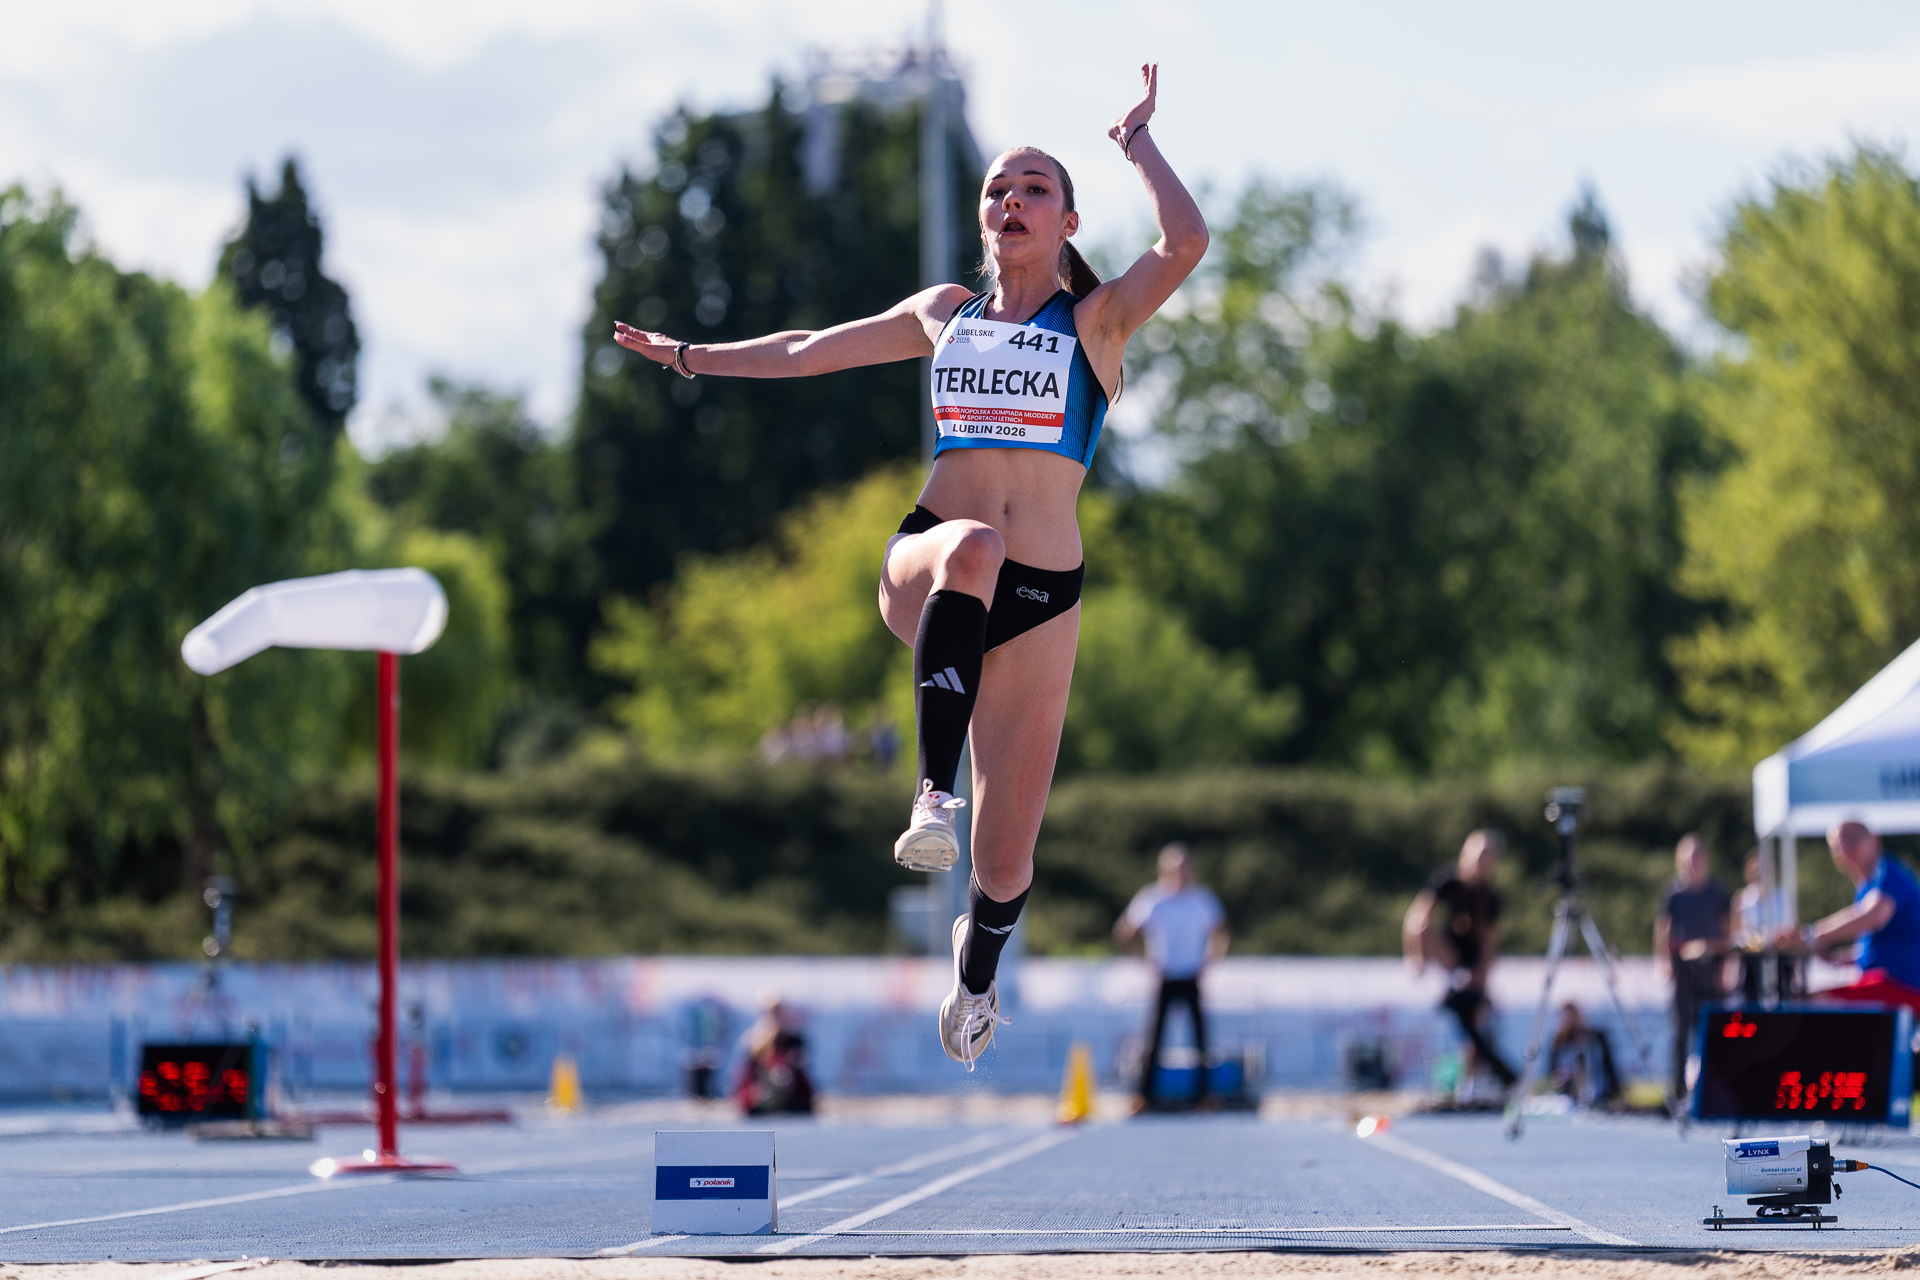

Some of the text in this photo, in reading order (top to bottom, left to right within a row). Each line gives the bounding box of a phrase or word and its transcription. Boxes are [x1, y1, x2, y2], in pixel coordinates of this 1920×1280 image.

[957, 329, 995, 337] LUBELSKIE
[1008, 330, 1059, 354] 441
[935, 368, 1060, 399] TERLECKA
[945, 406, 990, 415] OGÓLNOPOLSKA
[991, 409, 1023, 417] OLIMPIADA
[1024, 411, 1056, 420] MŁODZIEŻY
[953, 424, 1026, 437] LUBLIN 2026
